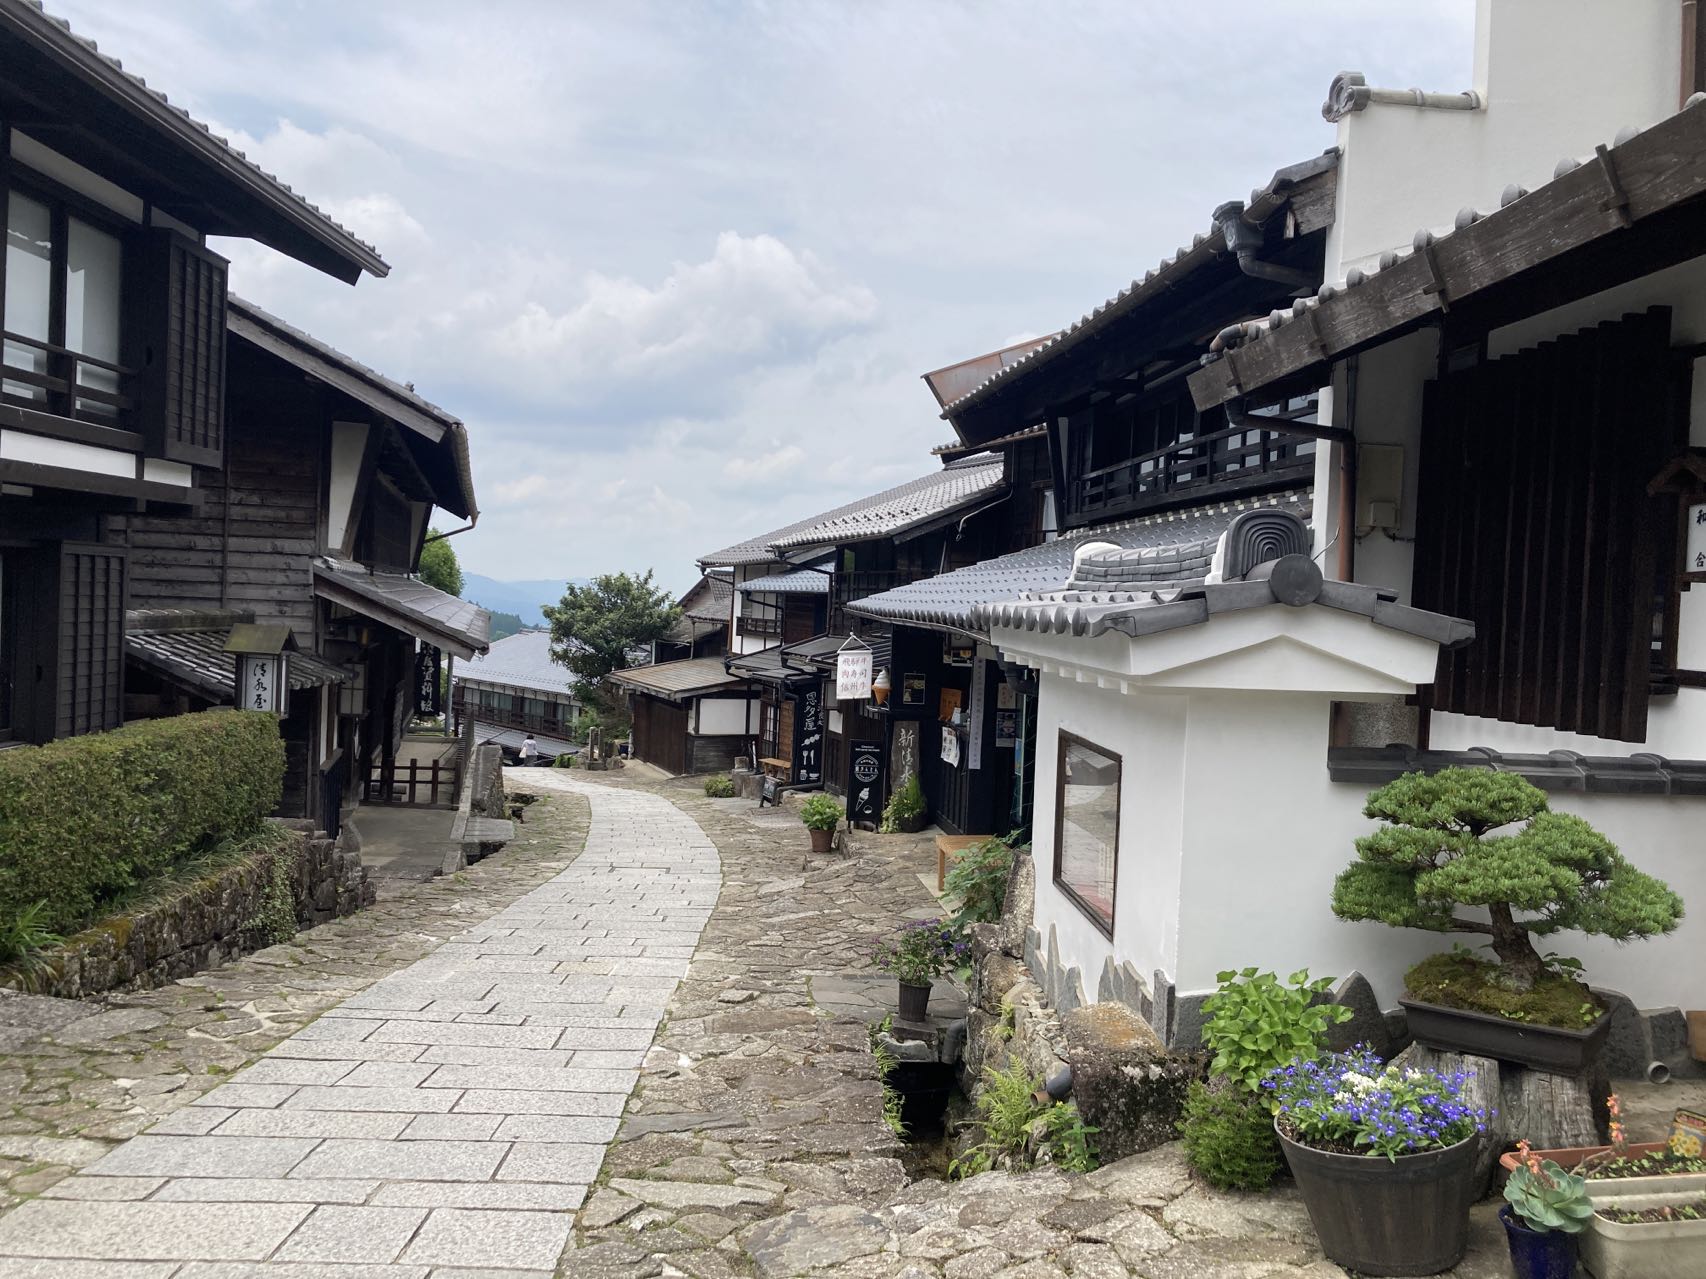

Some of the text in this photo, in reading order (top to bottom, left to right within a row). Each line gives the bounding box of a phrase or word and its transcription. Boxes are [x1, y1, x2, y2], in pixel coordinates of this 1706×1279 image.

[253, 663, 269, 710] 清水屋
[897, 728, 916, 783] 新清水
